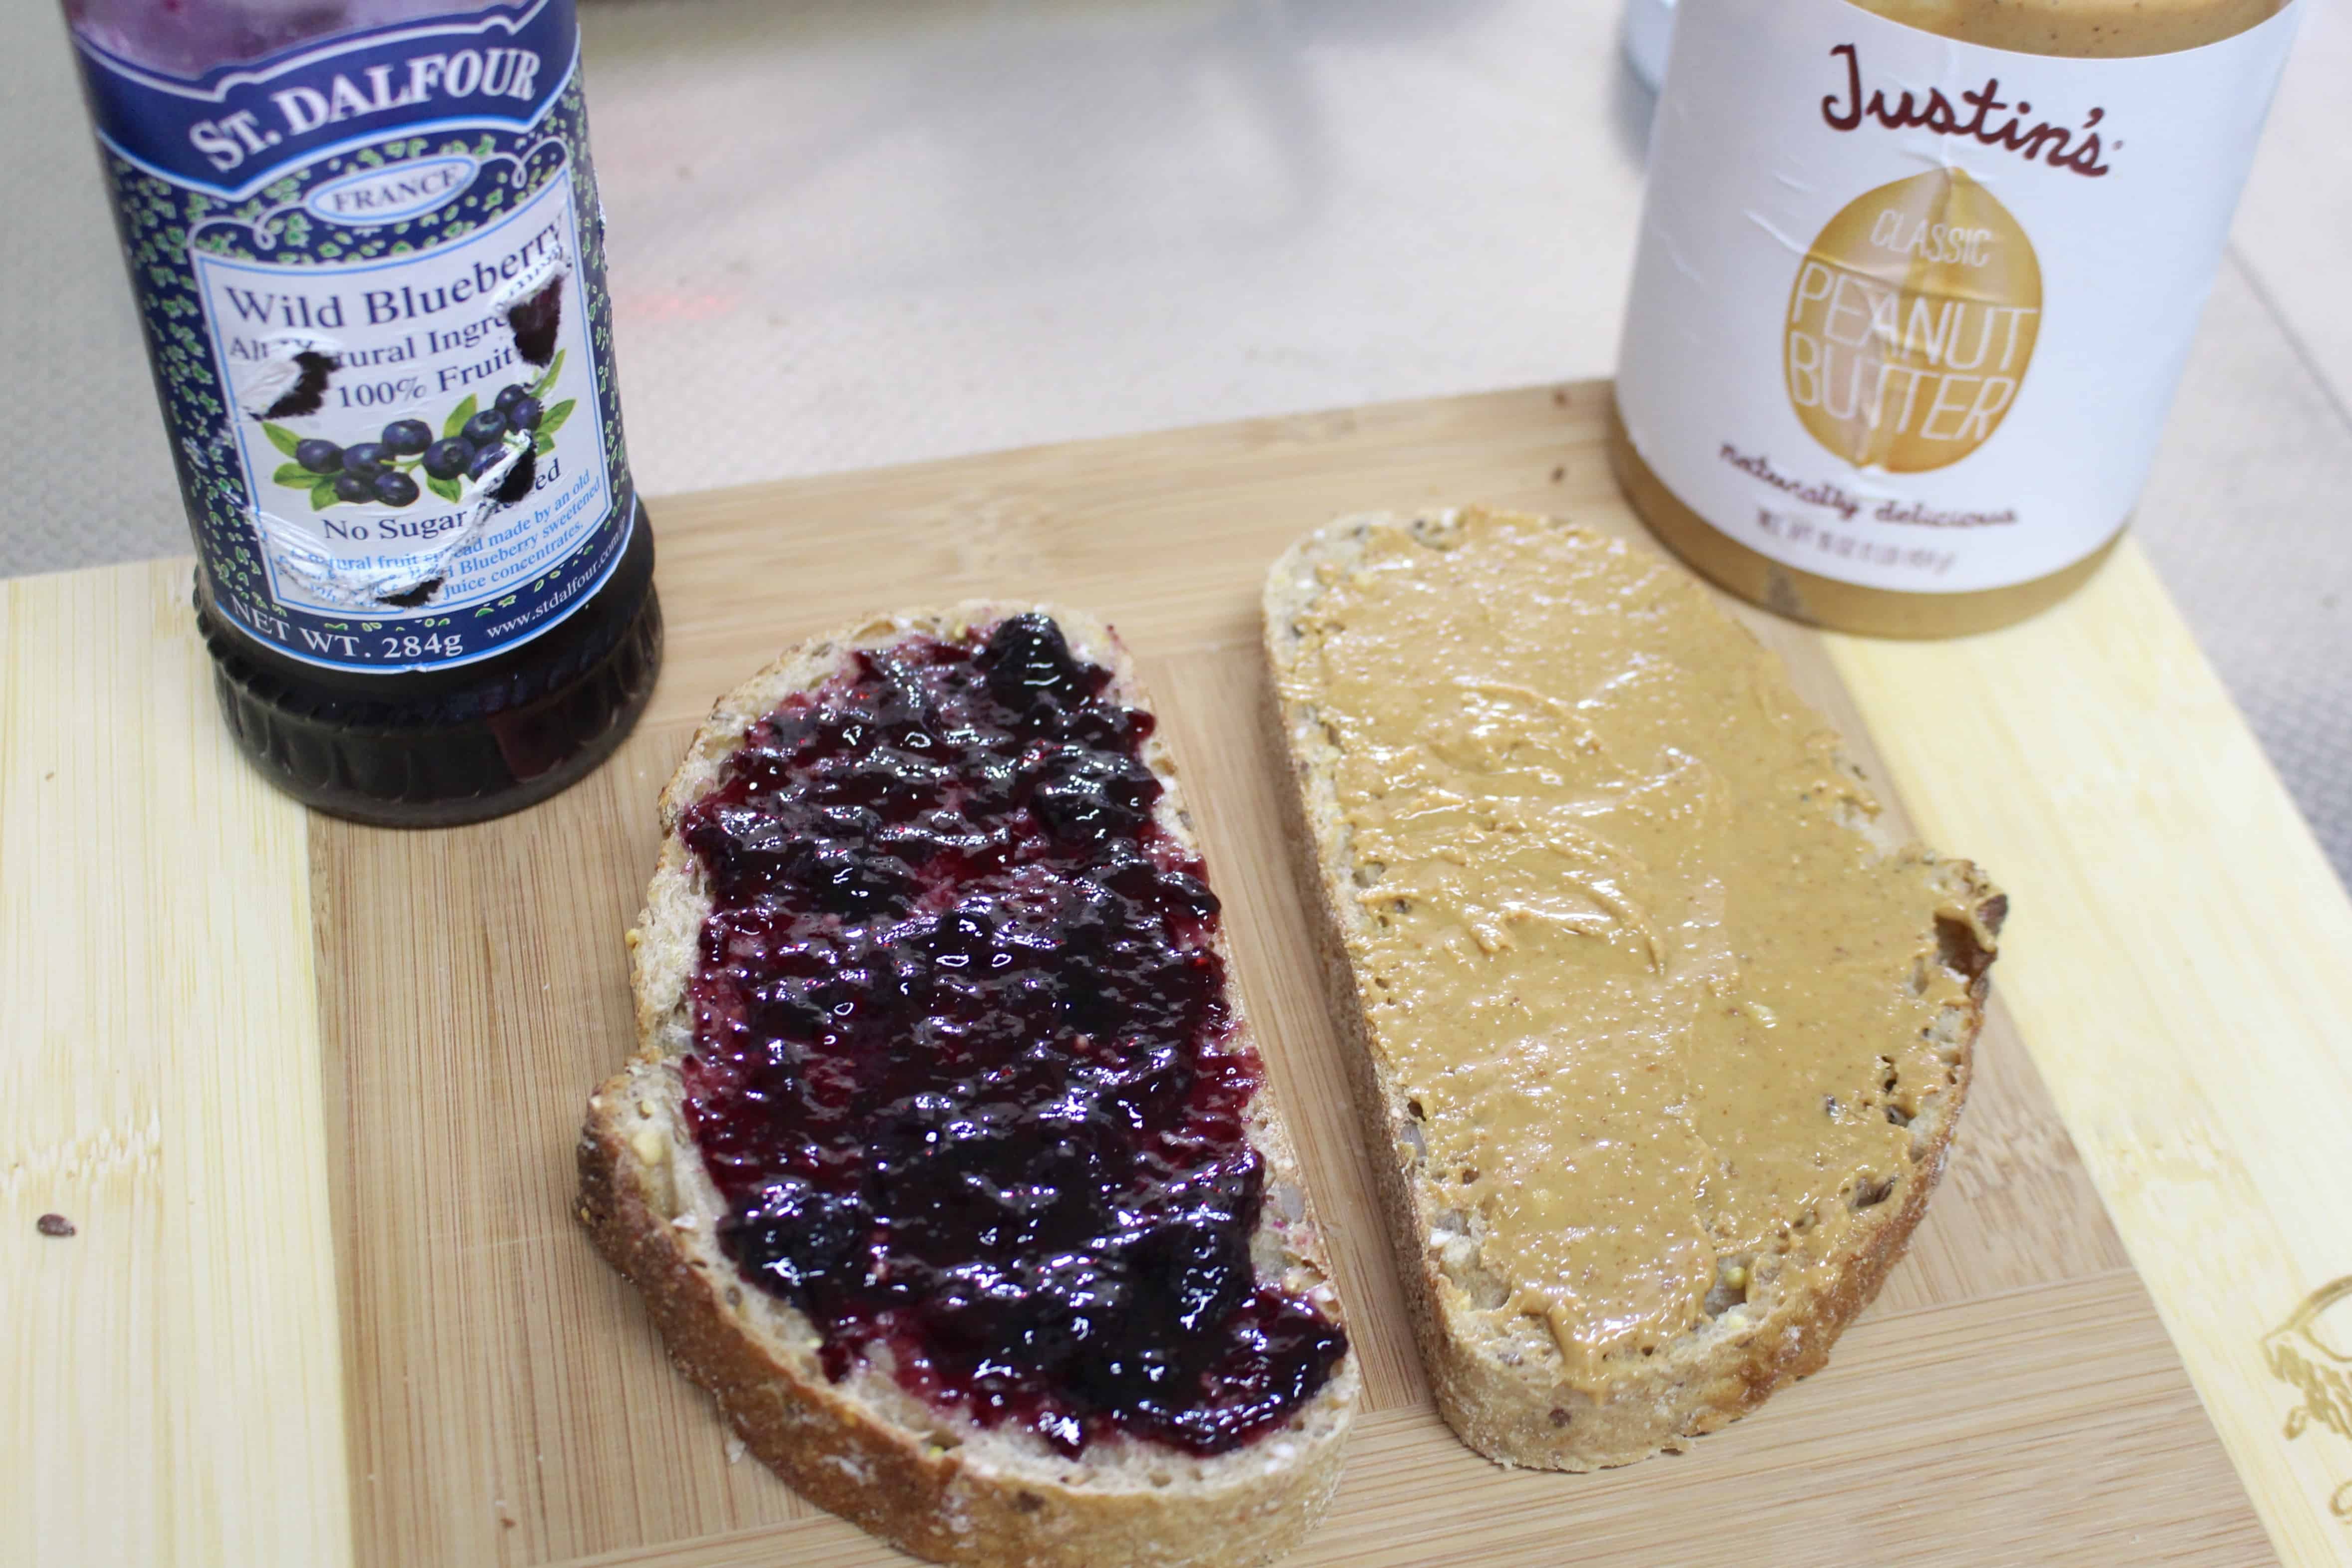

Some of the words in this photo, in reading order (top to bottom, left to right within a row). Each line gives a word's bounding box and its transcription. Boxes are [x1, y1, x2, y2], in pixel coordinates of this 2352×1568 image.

[189, 110, 281, 172] ST.
[270, 48, 541, 137] DALFOUR
[1821, 42, 2110, 178] Justin's
[333, 167, 459, 213] FRANCE
[1870, 209, 1992, 267] CLASSIC
[224, 286, 346, 329] Wild
[1792, 261, 2039, 372] PEANUT
[338, 376, 427, 408] 100%
[437, 348, 512, 393] Fruit
[1789, 331, 2016, 442] BUTTER
[322, 519, 369, 540] No
[379, 510, 467, 540] Sugar
[377, 553, 419, 569] fruit
[489, 519, 532, 547] made
[535, 507, 552, 523] by
[554, 492, 571, 512] an
[573, 468, 590, 495] old
[460, 533, 539, 576] Blueberry
[542, 476, 601, 537] sweetened
[443, 576, 487, 600] juice
[491, 522, 584, 582] concentrates.
[232, 594, 290, 641] NET
[299, 627, 371, 658] WT.
[382, 633, 463, 658] 284g
